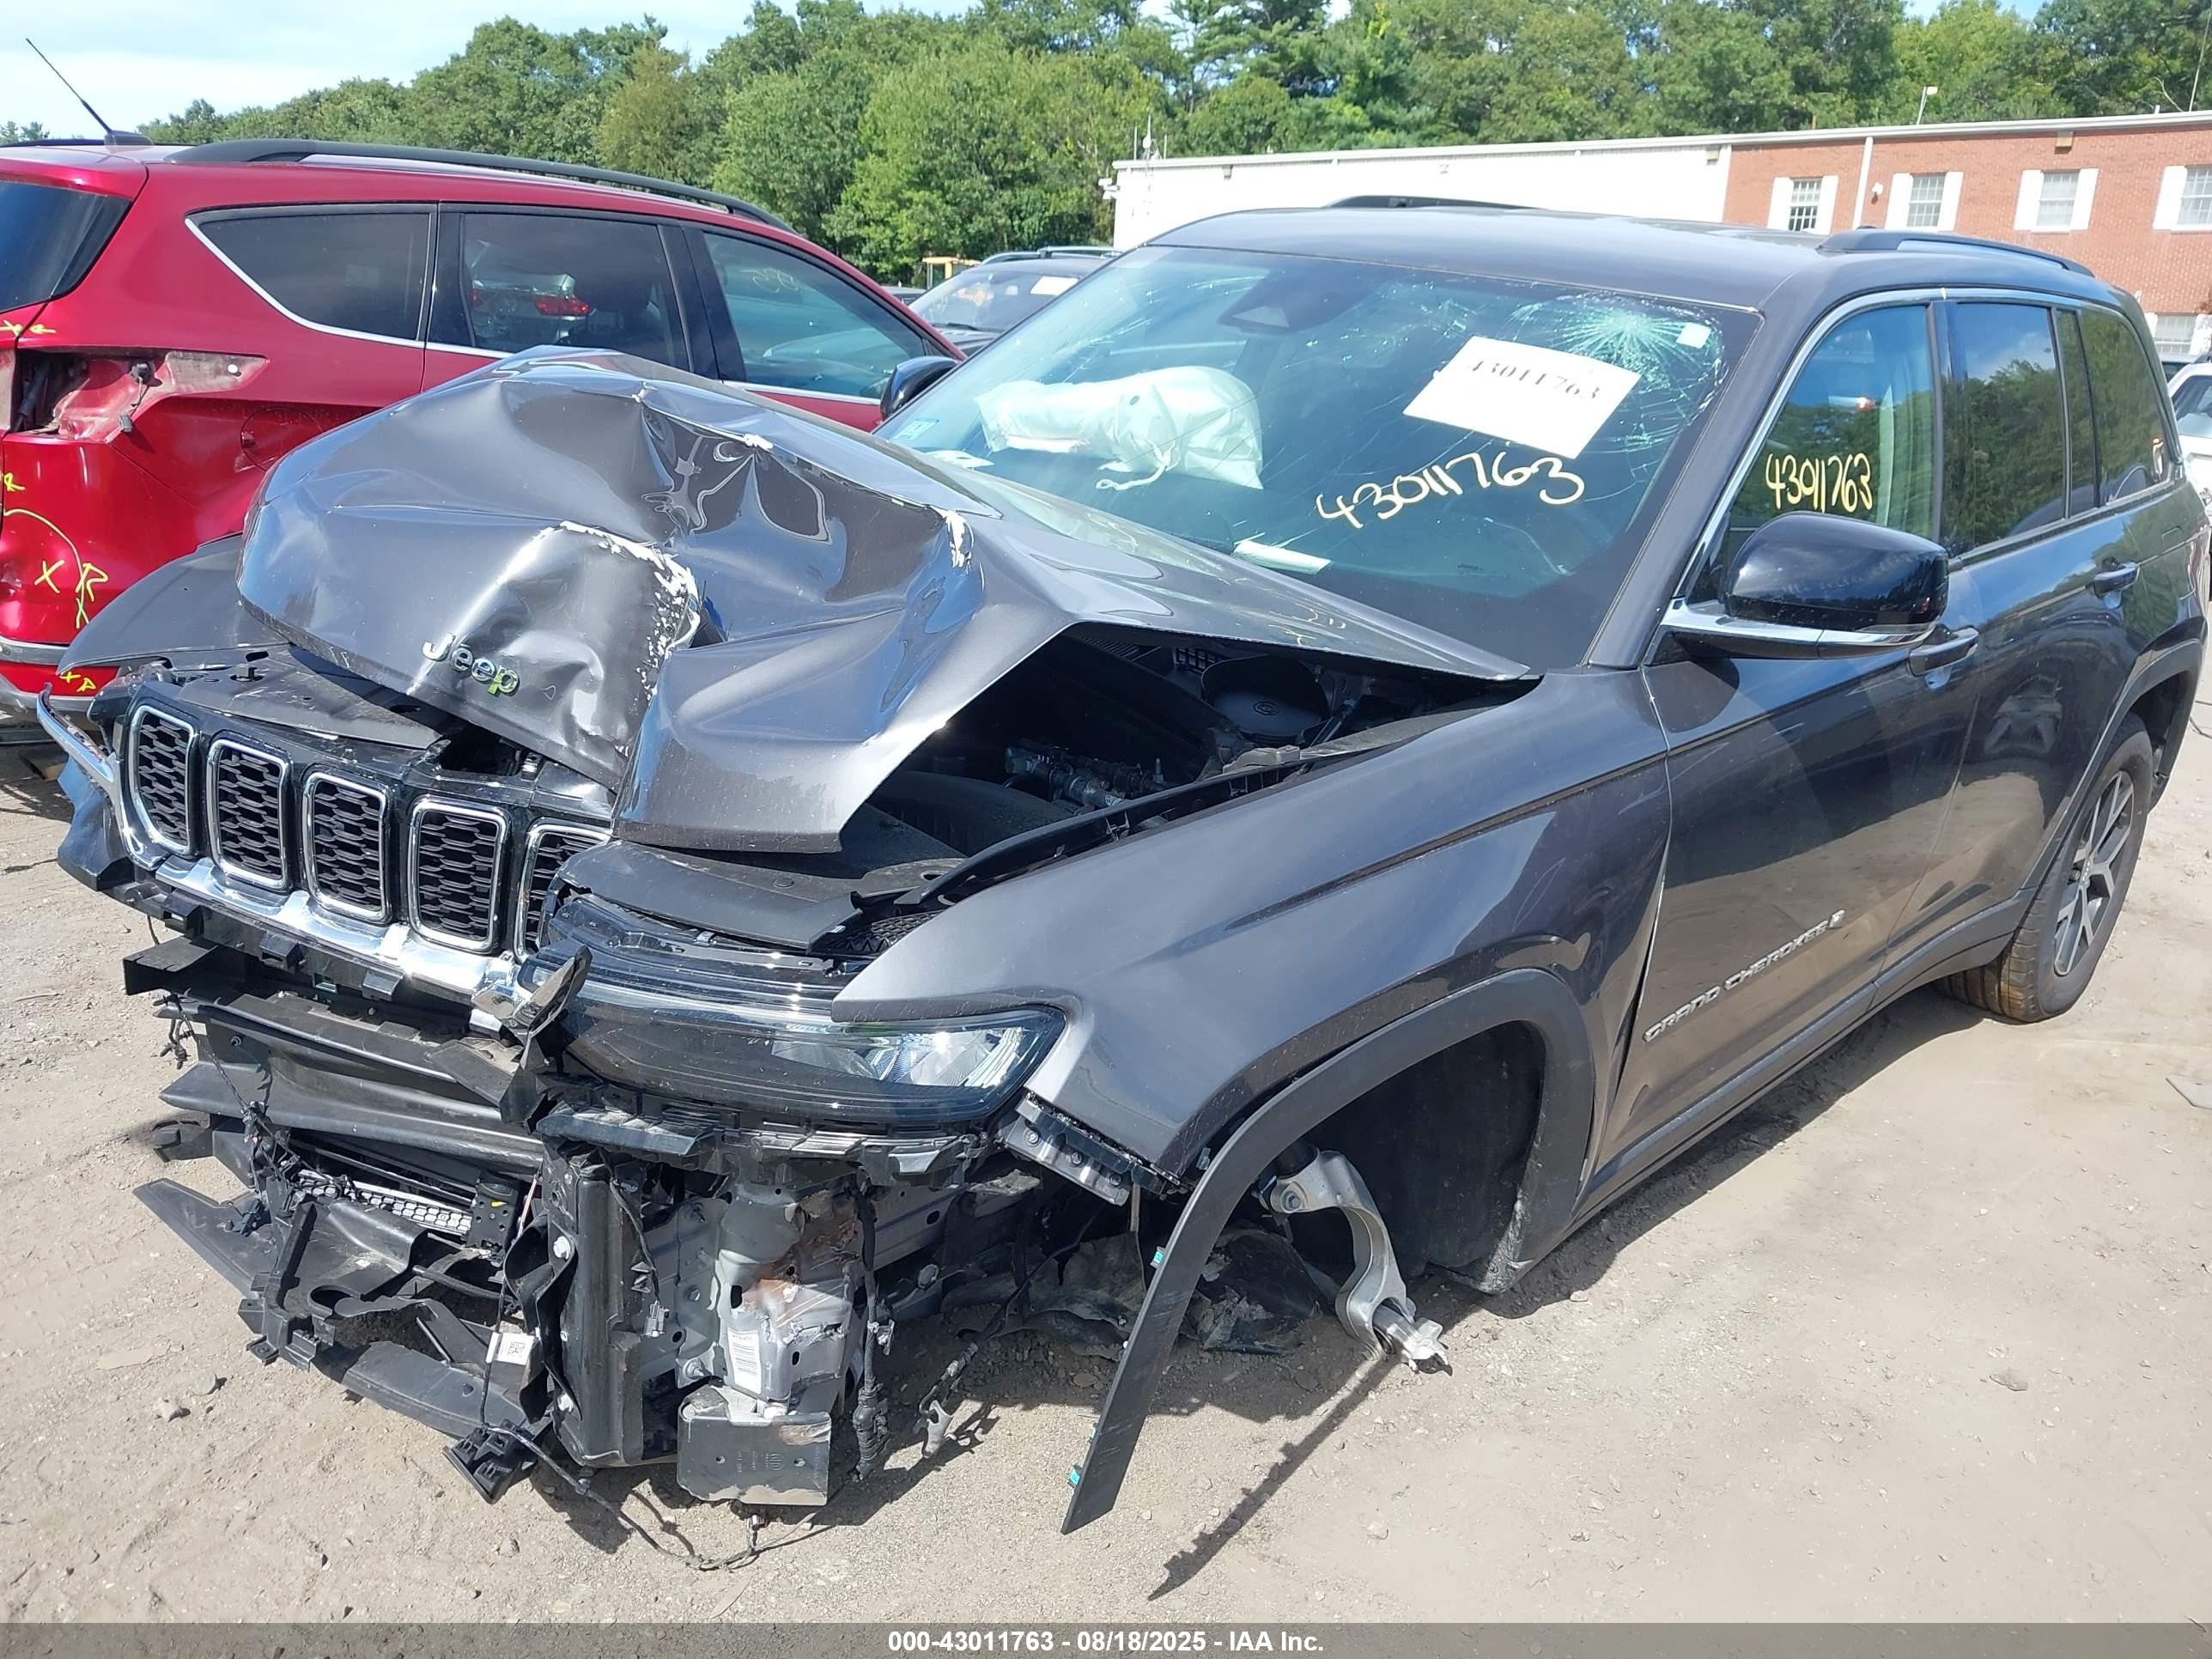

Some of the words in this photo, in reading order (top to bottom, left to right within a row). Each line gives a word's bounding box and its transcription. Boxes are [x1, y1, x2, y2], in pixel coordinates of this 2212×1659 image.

[1316, 451, 1585, 529] 43011763
[422, 632, 520, 696] Jeep
[1644, 987, 1721, 1042] GRAND
[1724, 920, 1829, 990] CHEROKEE
